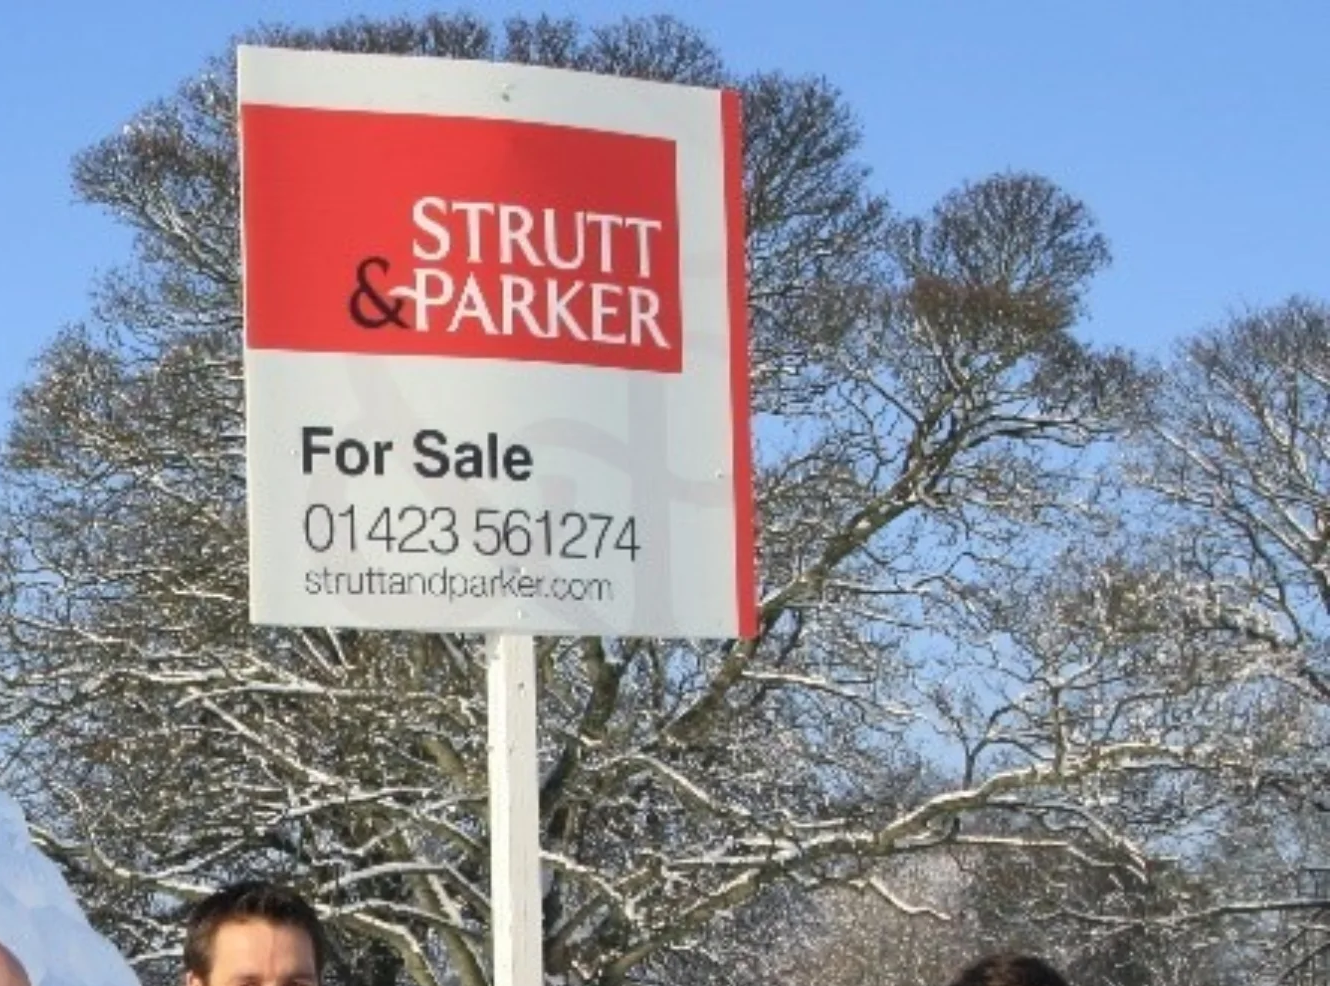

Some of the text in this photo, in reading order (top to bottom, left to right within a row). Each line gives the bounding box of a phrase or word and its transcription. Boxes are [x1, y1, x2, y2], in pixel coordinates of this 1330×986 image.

[411, 196, 662, 279] STRUTT
[301, 426, 533, 481] For Sale
[303, 504, 641, 562] 01423 561274
[305, 567, 611, 601] struttandparker.com
